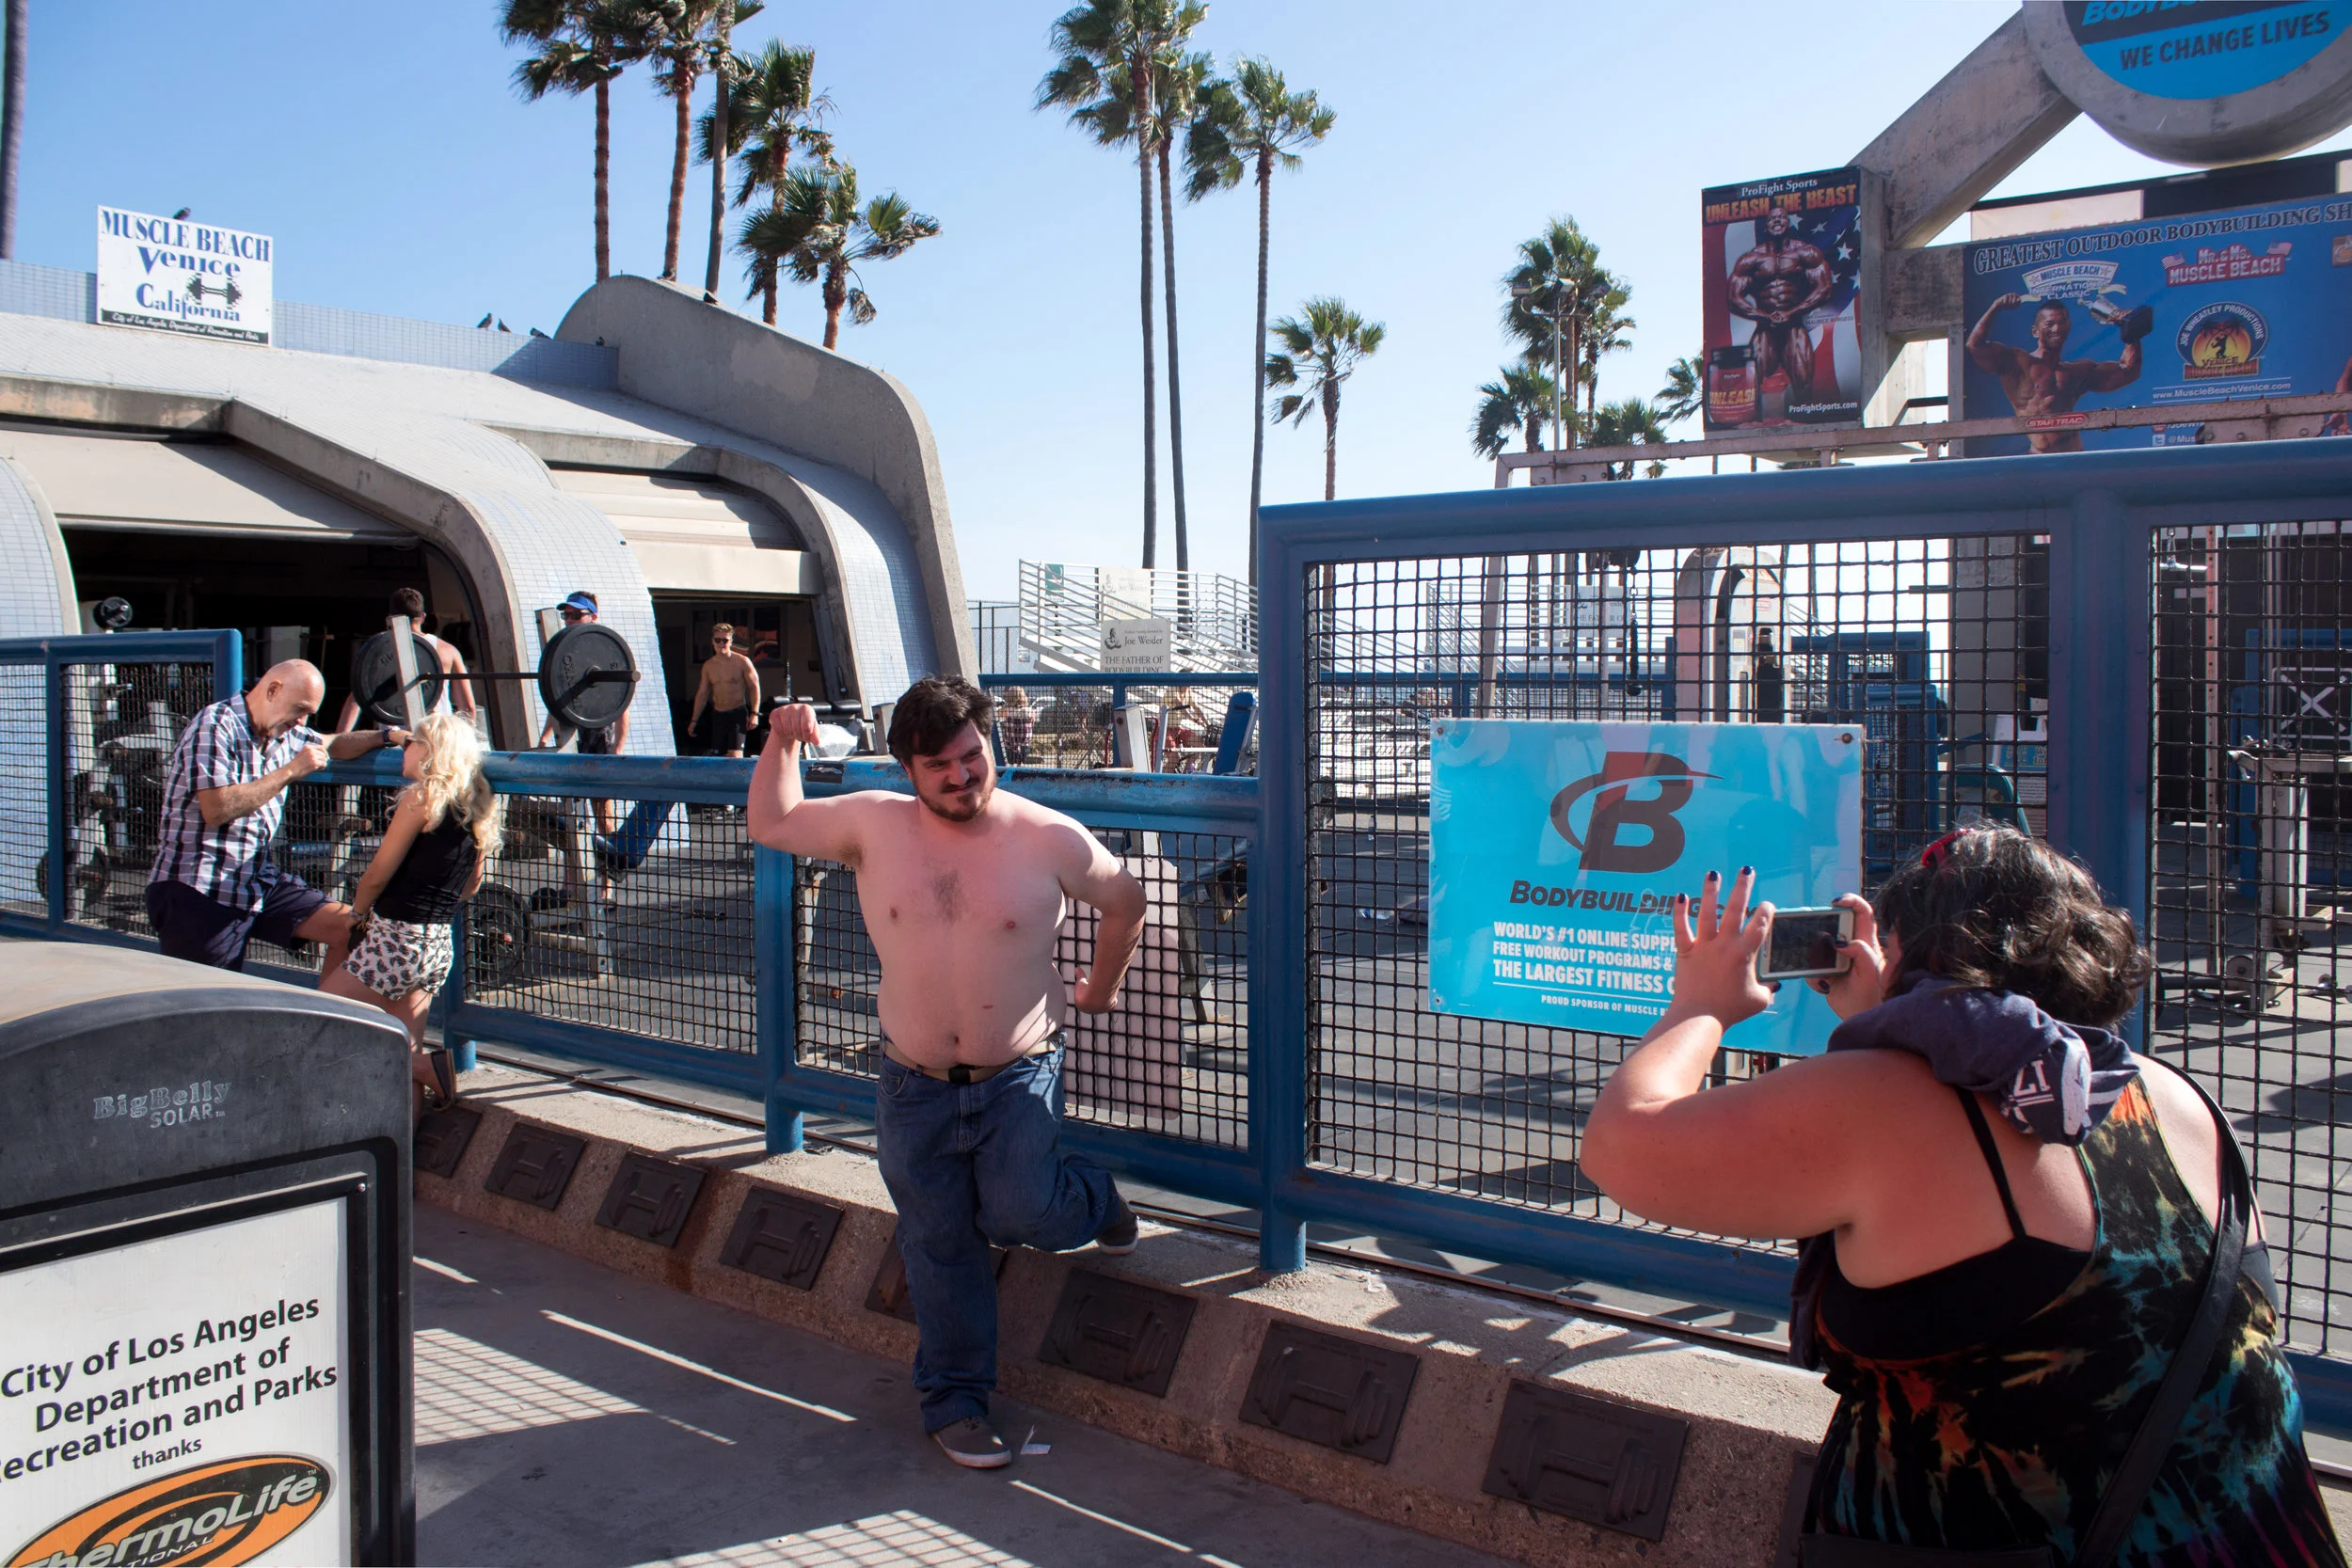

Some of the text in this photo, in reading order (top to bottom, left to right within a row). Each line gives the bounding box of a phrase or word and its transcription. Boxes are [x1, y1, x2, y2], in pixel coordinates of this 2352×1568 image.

[2120, 10, 2331, 71] WE CHANGE LIVES
[1706, 183, 1856, 223] UNLEASH THE BEAST
[1741, 179, 1818, 197] ProFight Sports
[102, 210, 270, 262] MUSCLE BEACH
[1975, 239, 2064, 275] GREATEST
[2066, 226, 2163, 256] OUTDOOR
[2166, 206, 2320, 242] BODYBUILDING
[136, 245, 241, 277] Venice
[2041, 265, 2100, 281] MUSCLE BEACH
[2169, 257, 2281, 284] MUSCLE BEACH
[136, 283, 241, 322] California
[2179, 304, 2265, 346] JOE WHEATLEY PRODUCTIONS
[2153, 383, 2291, 399] www.MuscleBeachVenice.com
[1788, 402, 1858, 414] ProFightSports.com
[2056, 416, 2084, 425] TRAC
[1124, 634, 1164, 647] Joe Weider
[1104, 655, 1164, 664] THE FATHER OF
[1493, 921, 1554, 941] WORLD'S
[1557, 927, 1574, 942] #1
[1577, 929, 1629, 948] ONLINE
[1493, 941, 1673, 972] FREE WORKOUT PROGRAMS &
[1493, 958, 1521, 979] THE
[1525, 962, 1594, 987] LARGEST
[1597, 969, 1664, 994] FITNESS
[1541, 994, 1569, 1006] PROUD
[1571, 997, 1610, 1010] SPONSOR
[1612, 1003, 1623, 1012] OF
[1625, 1004, 1658, 1016] MUSCLE
[93, 1080, 232, 1120] BigBelly
[150, 1102, 213, 1129] SOLAR
[1, 1298, 321, 1398] City of Los Angeles
[36, 1336, 292, 1433] Department of
[0, 1365, 338, 1483] ecreation and Parks
[132, 1436, 203, 1470] thanks
